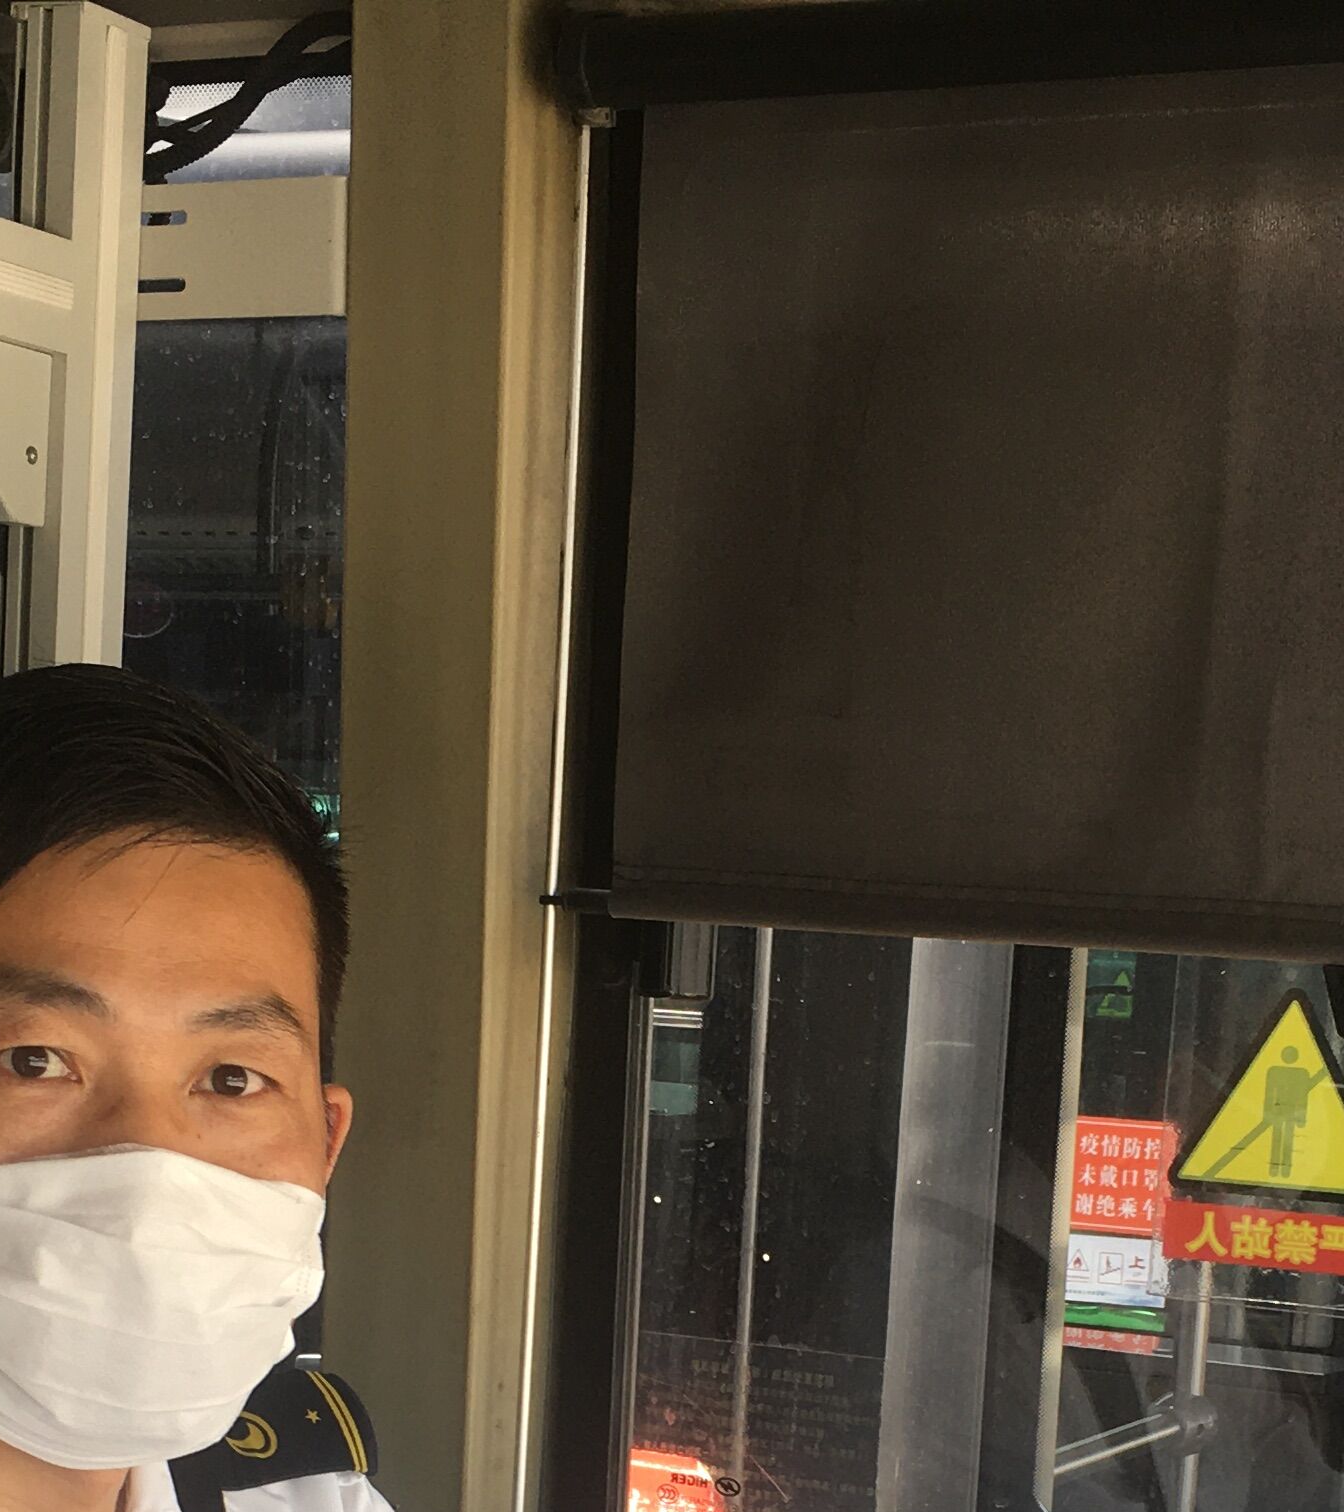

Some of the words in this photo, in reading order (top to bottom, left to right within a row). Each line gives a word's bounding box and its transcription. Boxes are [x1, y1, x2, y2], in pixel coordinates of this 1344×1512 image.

[1079, 1132, 1160, 1160] 疫情防控
[1078, 1163, 1159, 1191] 未戴口罩
[1075, 1192, 1156, 1222] 谢绝乘车
